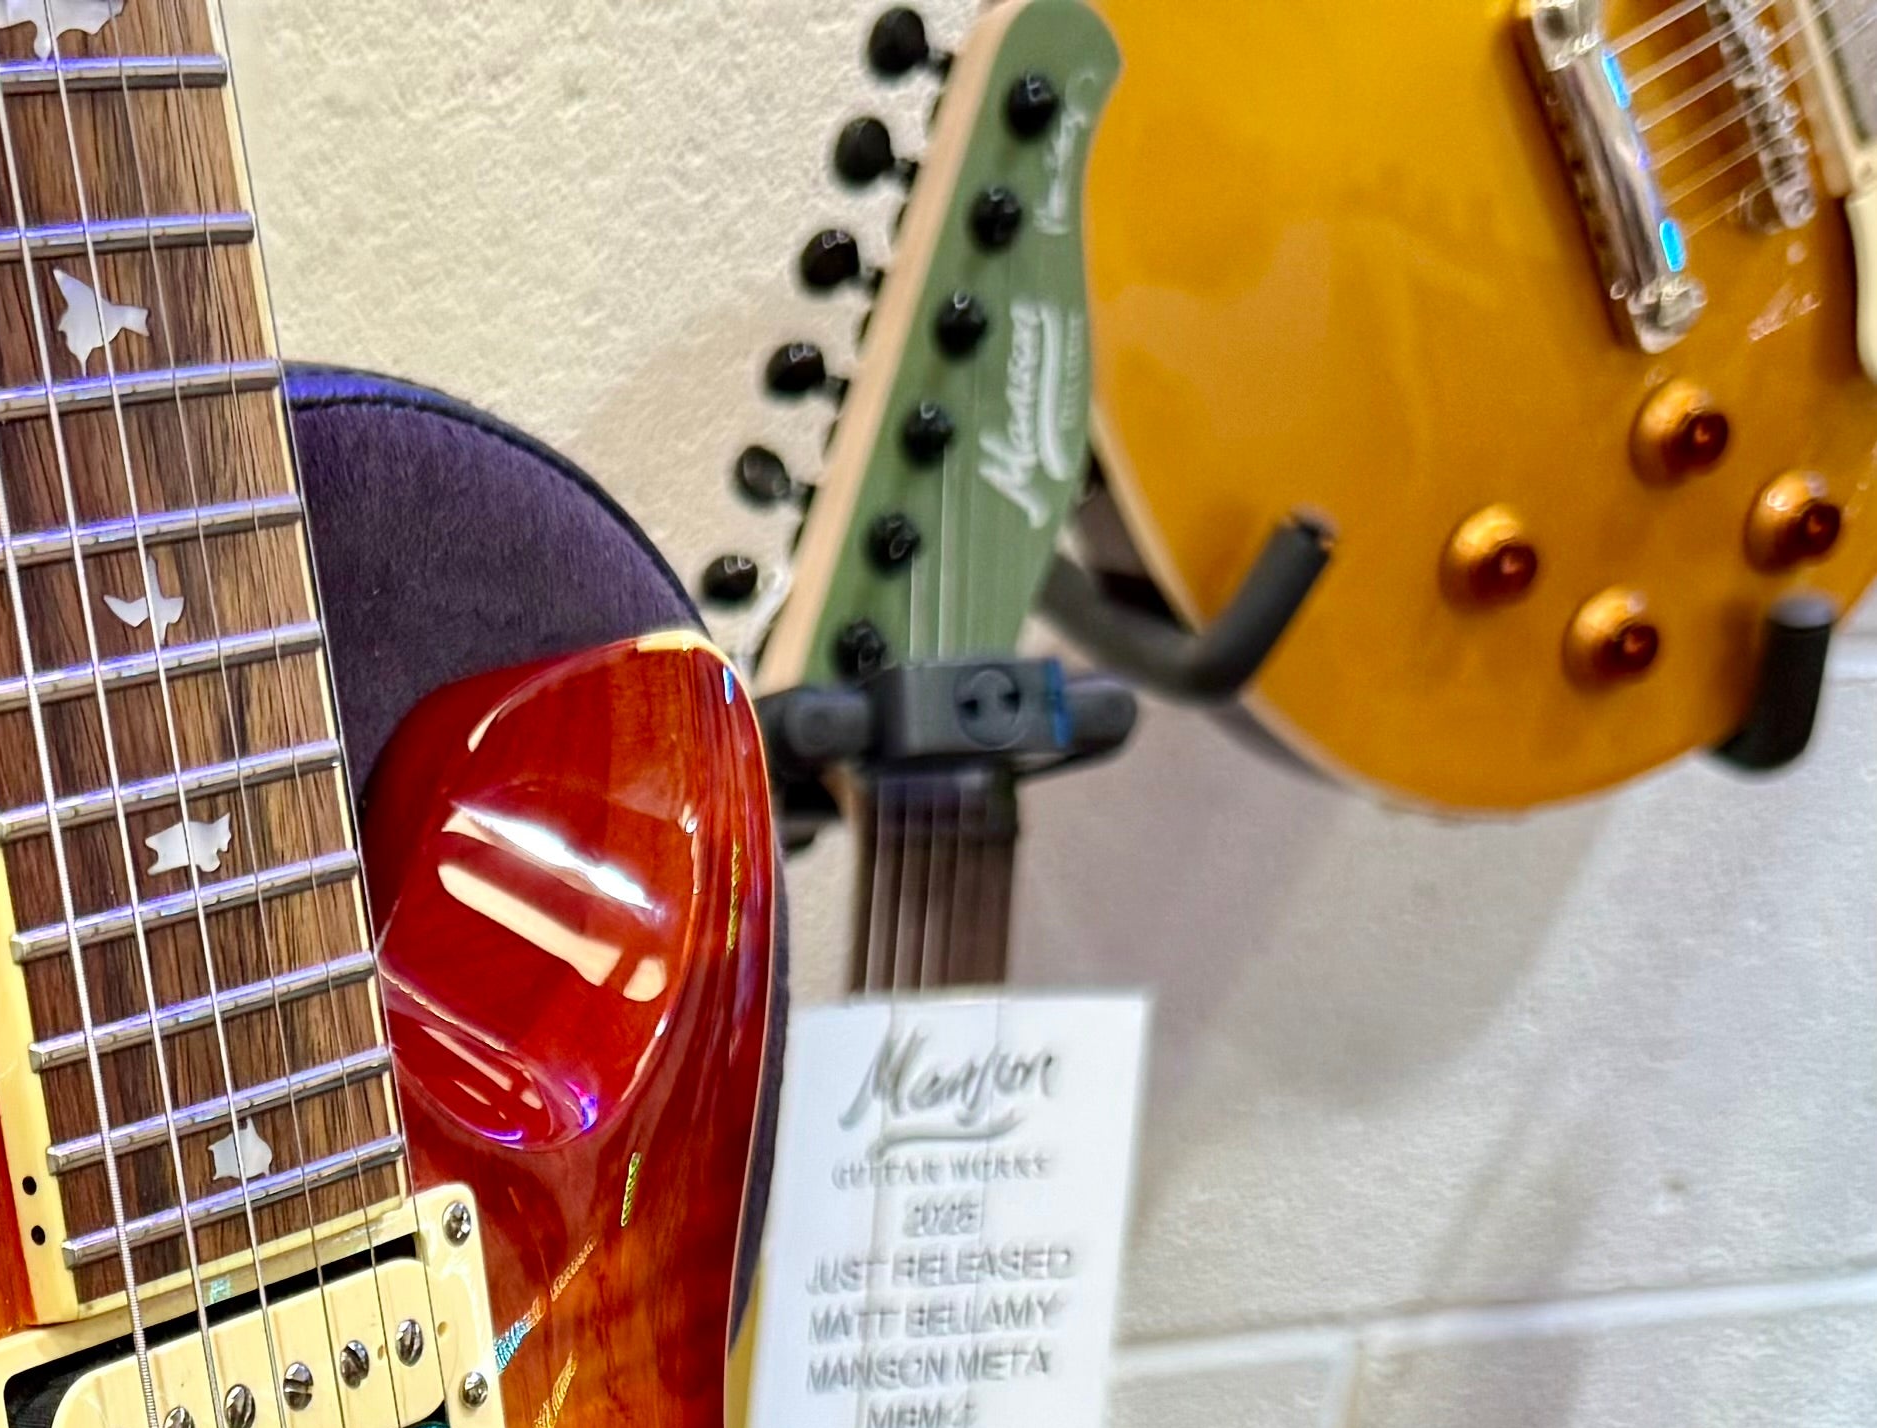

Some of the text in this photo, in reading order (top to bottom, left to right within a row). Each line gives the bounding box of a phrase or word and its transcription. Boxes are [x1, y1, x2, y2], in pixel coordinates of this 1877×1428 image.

[805, 1243, 1075, 1295] JUST RELEASED
[808, 1293, 1063, 1345] MATT BELLAMY
[806, 1339, 1051, 1394] MANSON META
